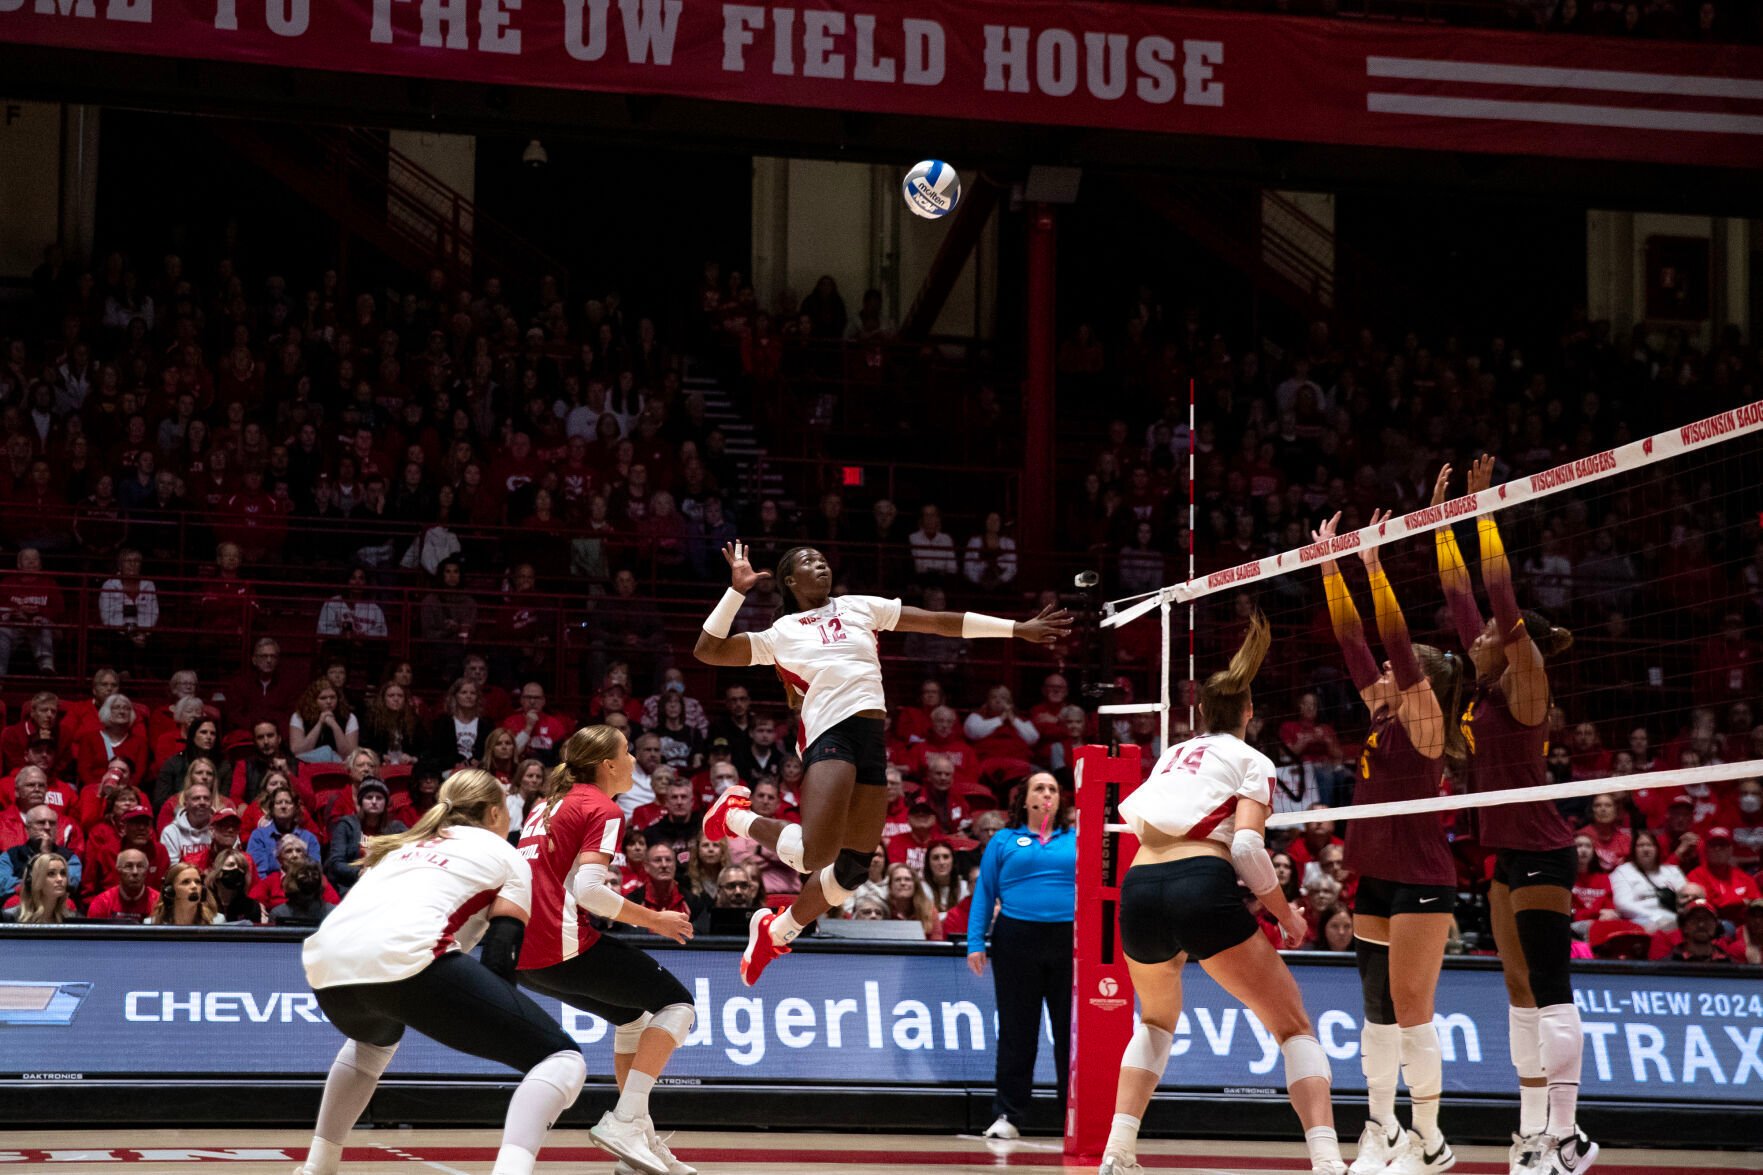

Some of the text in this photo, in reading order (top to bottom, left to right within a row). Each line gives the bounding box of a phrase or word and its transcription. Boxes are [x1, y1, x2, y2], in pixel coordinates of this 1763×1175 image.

[370, 0, 522, 55] THE
[563, 0, 683, 66] UW
[722, 4, 947, 86] FIELD
[983, 25, 1225, 107] HOUSE
[918, 182, 945, 206] molten
[1680, 411, 1736, 446] WISCONSIN
[1530, 450, 1617, 493] WISCONSIN BADGERS
[1404, 494, 1478, 531] WISCONSIN BADGERS
[817, 618, 847, 645] 12
[1161, 745, 1208, 775] 14
[125, 992, 330, 1022] CHEVR
[1573, 989, 1763, 1017] ALL-NEW 2024
[1581, 1022, 1763, 1085] TRAX
